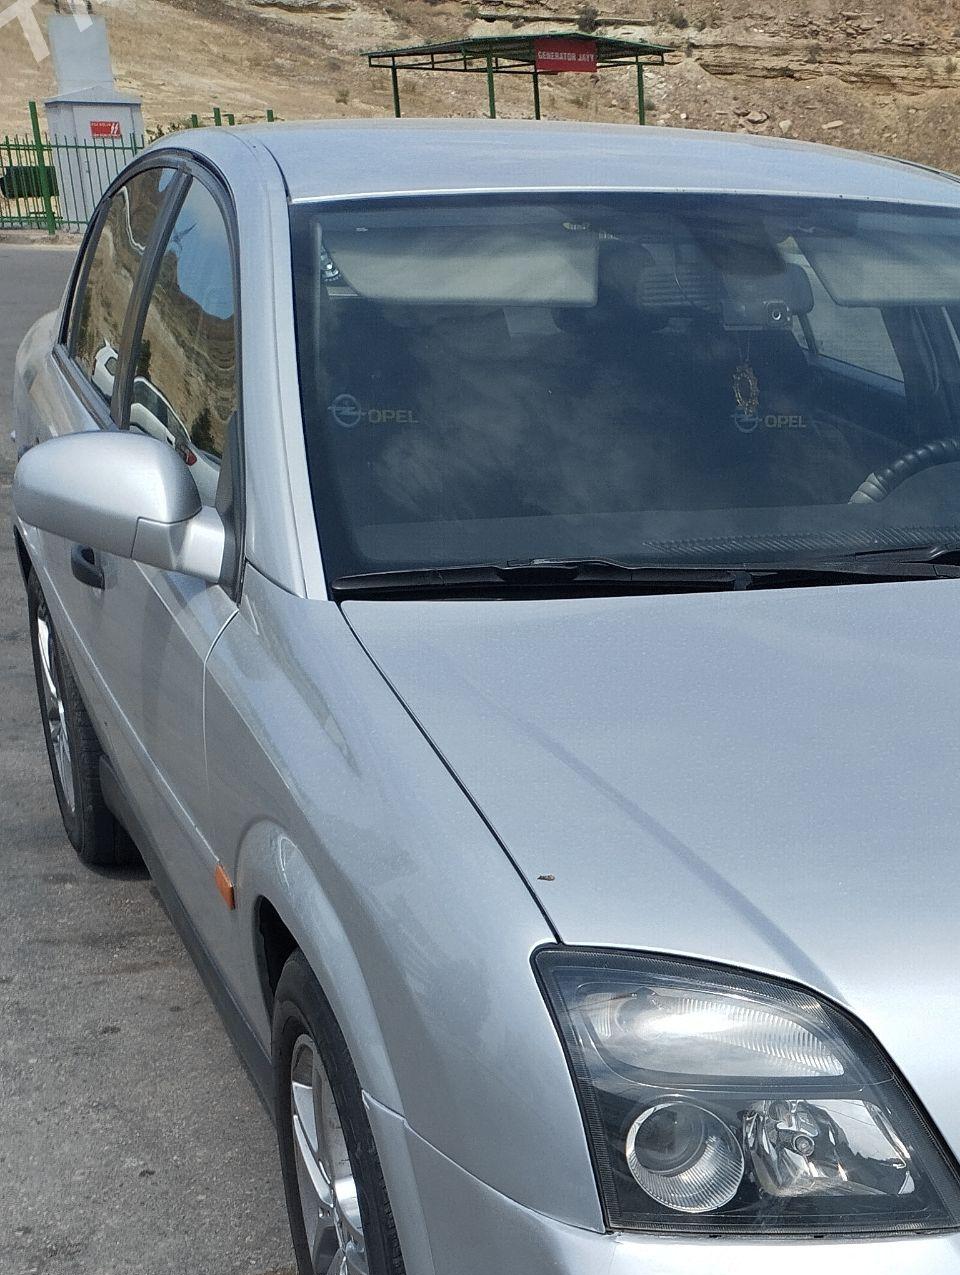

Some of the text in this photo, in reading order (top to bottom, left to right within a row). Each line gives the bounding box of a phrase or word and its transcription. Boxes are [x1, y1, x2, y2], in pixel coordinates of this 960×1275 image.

[537, 50, 577, 61] GENERATOR
[368, 409, 420, 424] OPEL
[764, 414, 808, 428] OPEL
